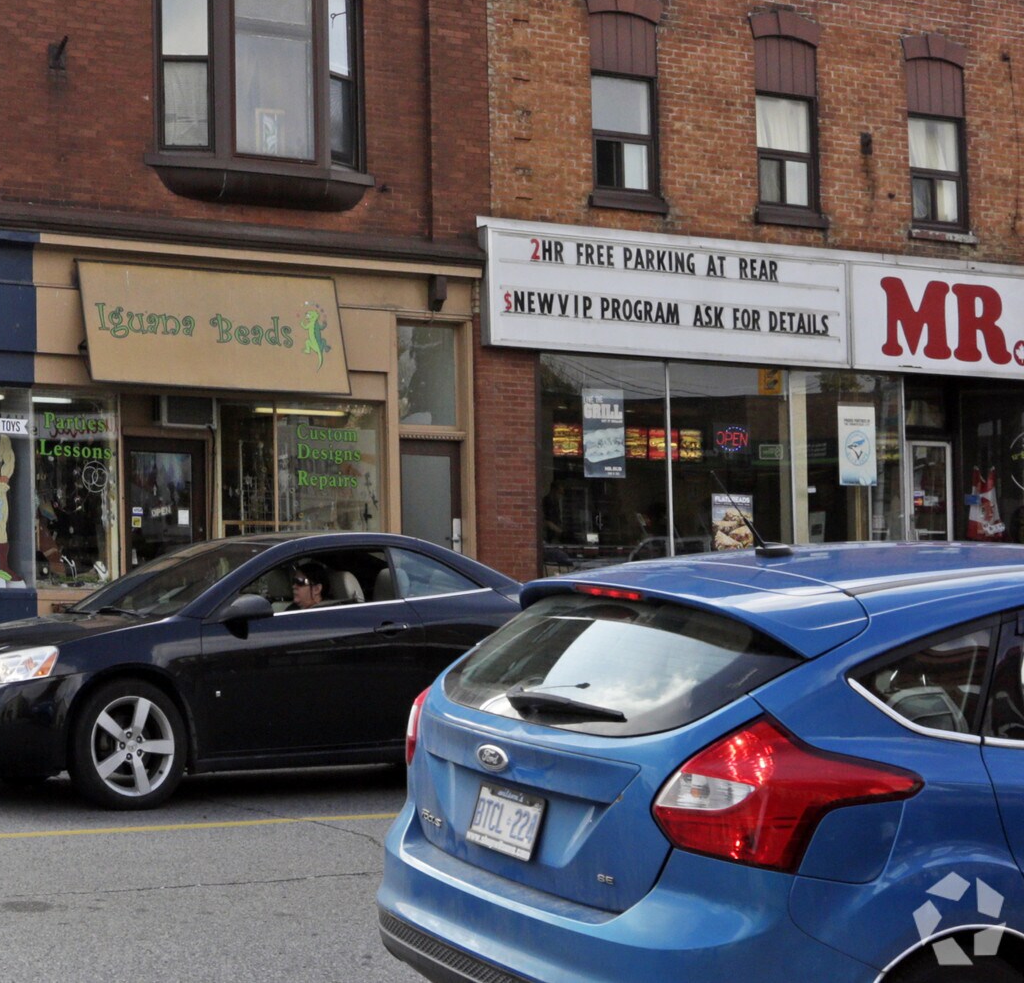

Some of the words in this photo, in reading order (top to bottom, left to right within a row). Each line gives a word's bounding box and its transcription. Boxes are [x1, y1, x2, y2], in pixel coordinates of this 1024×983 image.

[530, 238, 564, 264] 2HR
[576, 243, 614, 268] FREE
[623, 247, 695, 275] PARKING
[707, 255, 726, 278] AT
[739, 258, 778, 282] REAR
[94, 302, 195, 338] Iguana
[209, 313, 294, 349] Beads
[600, 298, 680, 325] PROGRAM
[693, 305, 724, 329] ASK
[733, 308, 761, 332] FOR
[769, 311, 830, 336] DETAILS
[1, 420, 21, 432] TOYS
[44, 411, 106, 433] Parties
[296, 423, 358, 442] Custom
[39, 438, 113, 460] Lessons
[716, 431, 748, 447] OPEN
[297, 443, 361, 464] Designs
[298, 470, 358, 490] Repairs
[151, 506, 172, 517] OPEN
